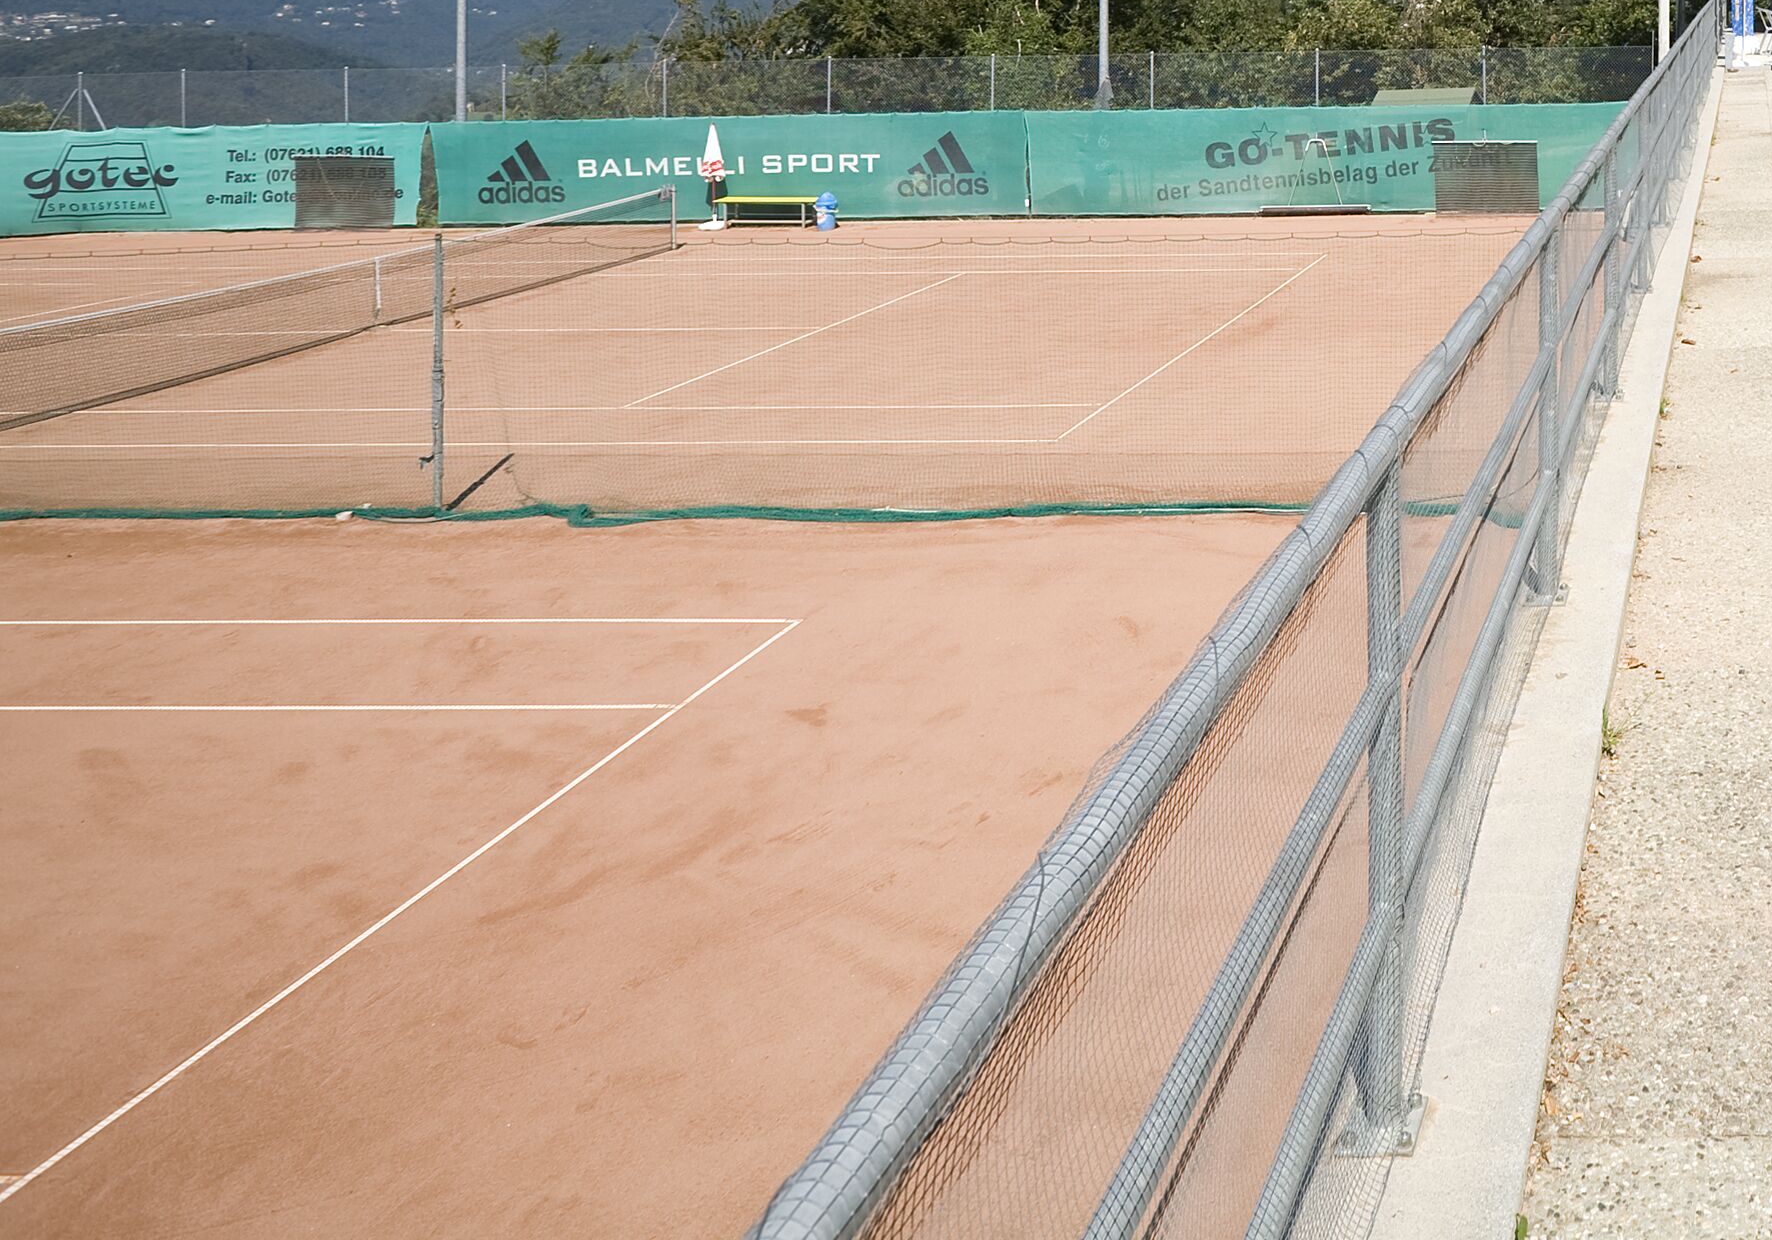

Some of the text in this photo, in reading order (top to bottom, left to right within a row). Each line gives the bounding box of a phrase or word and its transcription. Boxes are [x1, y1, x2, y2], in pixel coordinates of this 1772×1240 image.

[227, 149, 256, 162] Tel.:
[762, 154, 881, 174] SPORT
[23, 156, 179, 199] gotec
[225, 170, 256, 183] Fax:
[897, 173, 989, 197] adidas
[1157, 184, 1190, 201] der
[1198, 165, 1378, 197] Sandtennisbelag
[1385, 160, 1419, 178] der
[206, 191, 257, 205] e-mail:
[478, 181, 566, 204] adidas
[47, 200, 156, 212] SPORTSYSTEME
